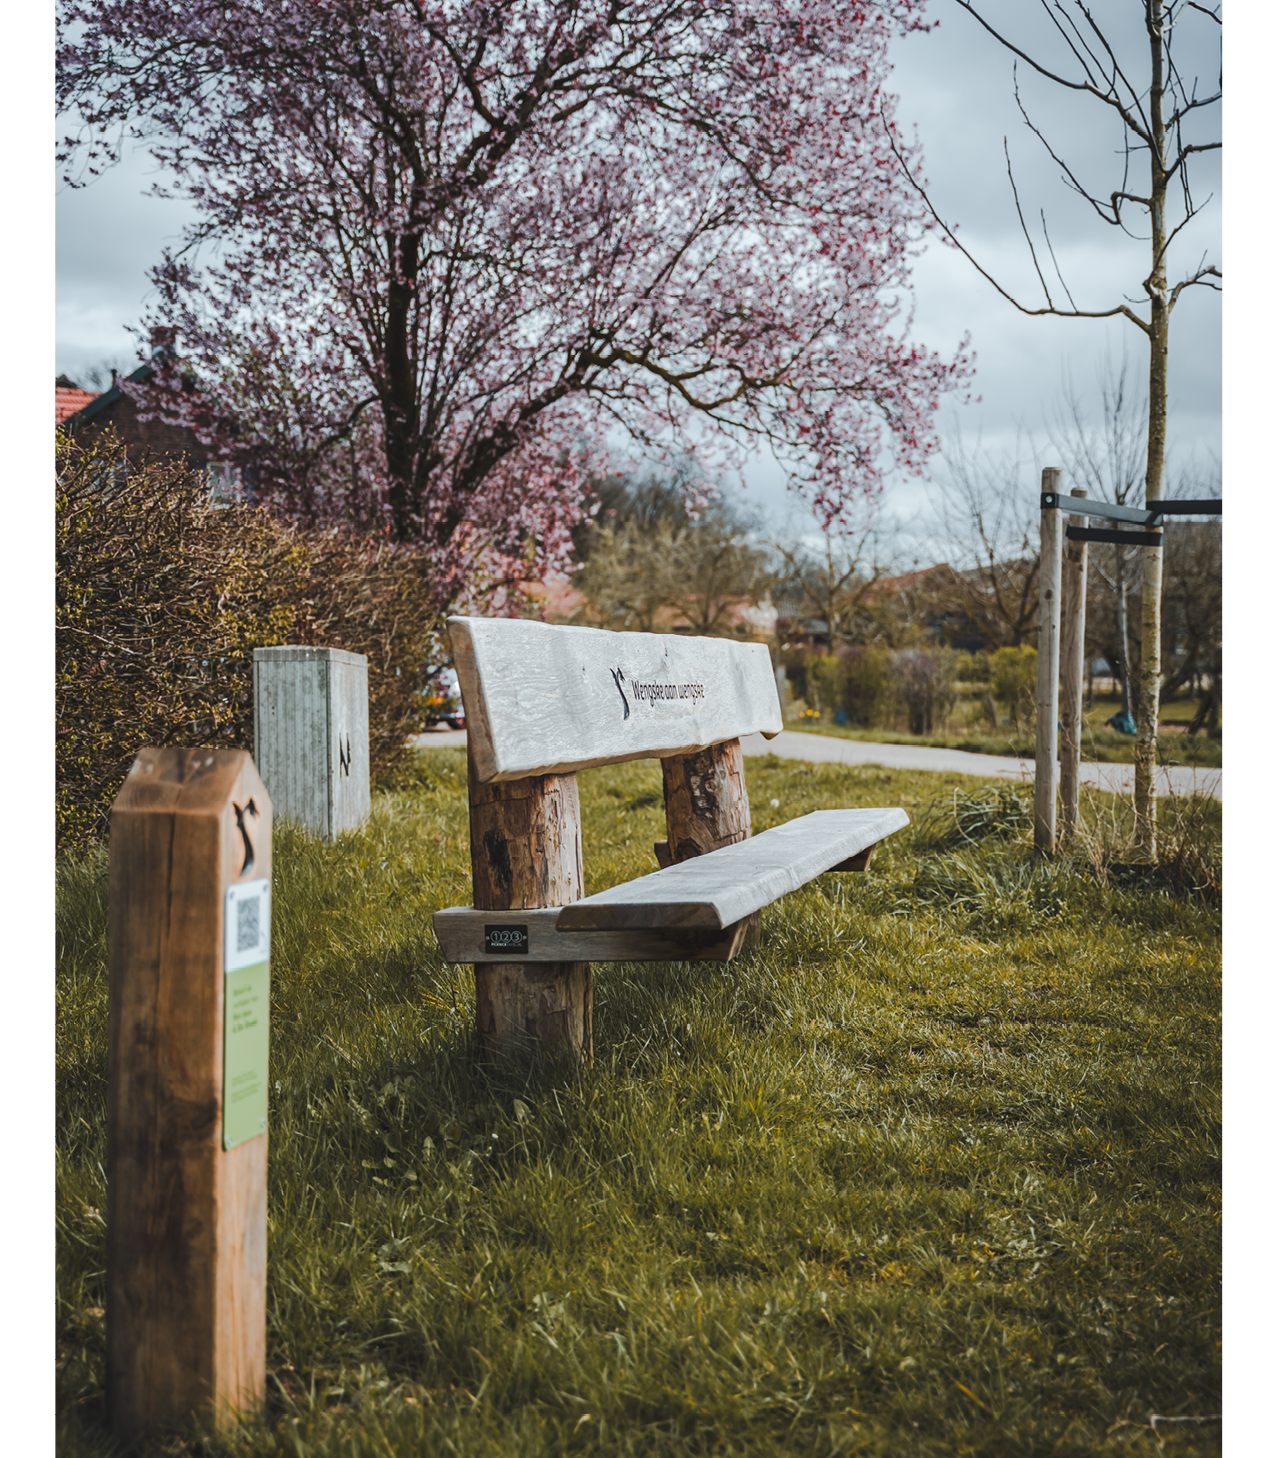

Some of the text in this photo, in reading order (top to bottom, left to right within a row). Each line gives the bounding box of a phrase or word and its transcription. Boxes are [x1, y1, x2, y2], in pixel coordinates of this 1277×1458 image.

[631, 680, 705, 707] Wengske aan wengske
